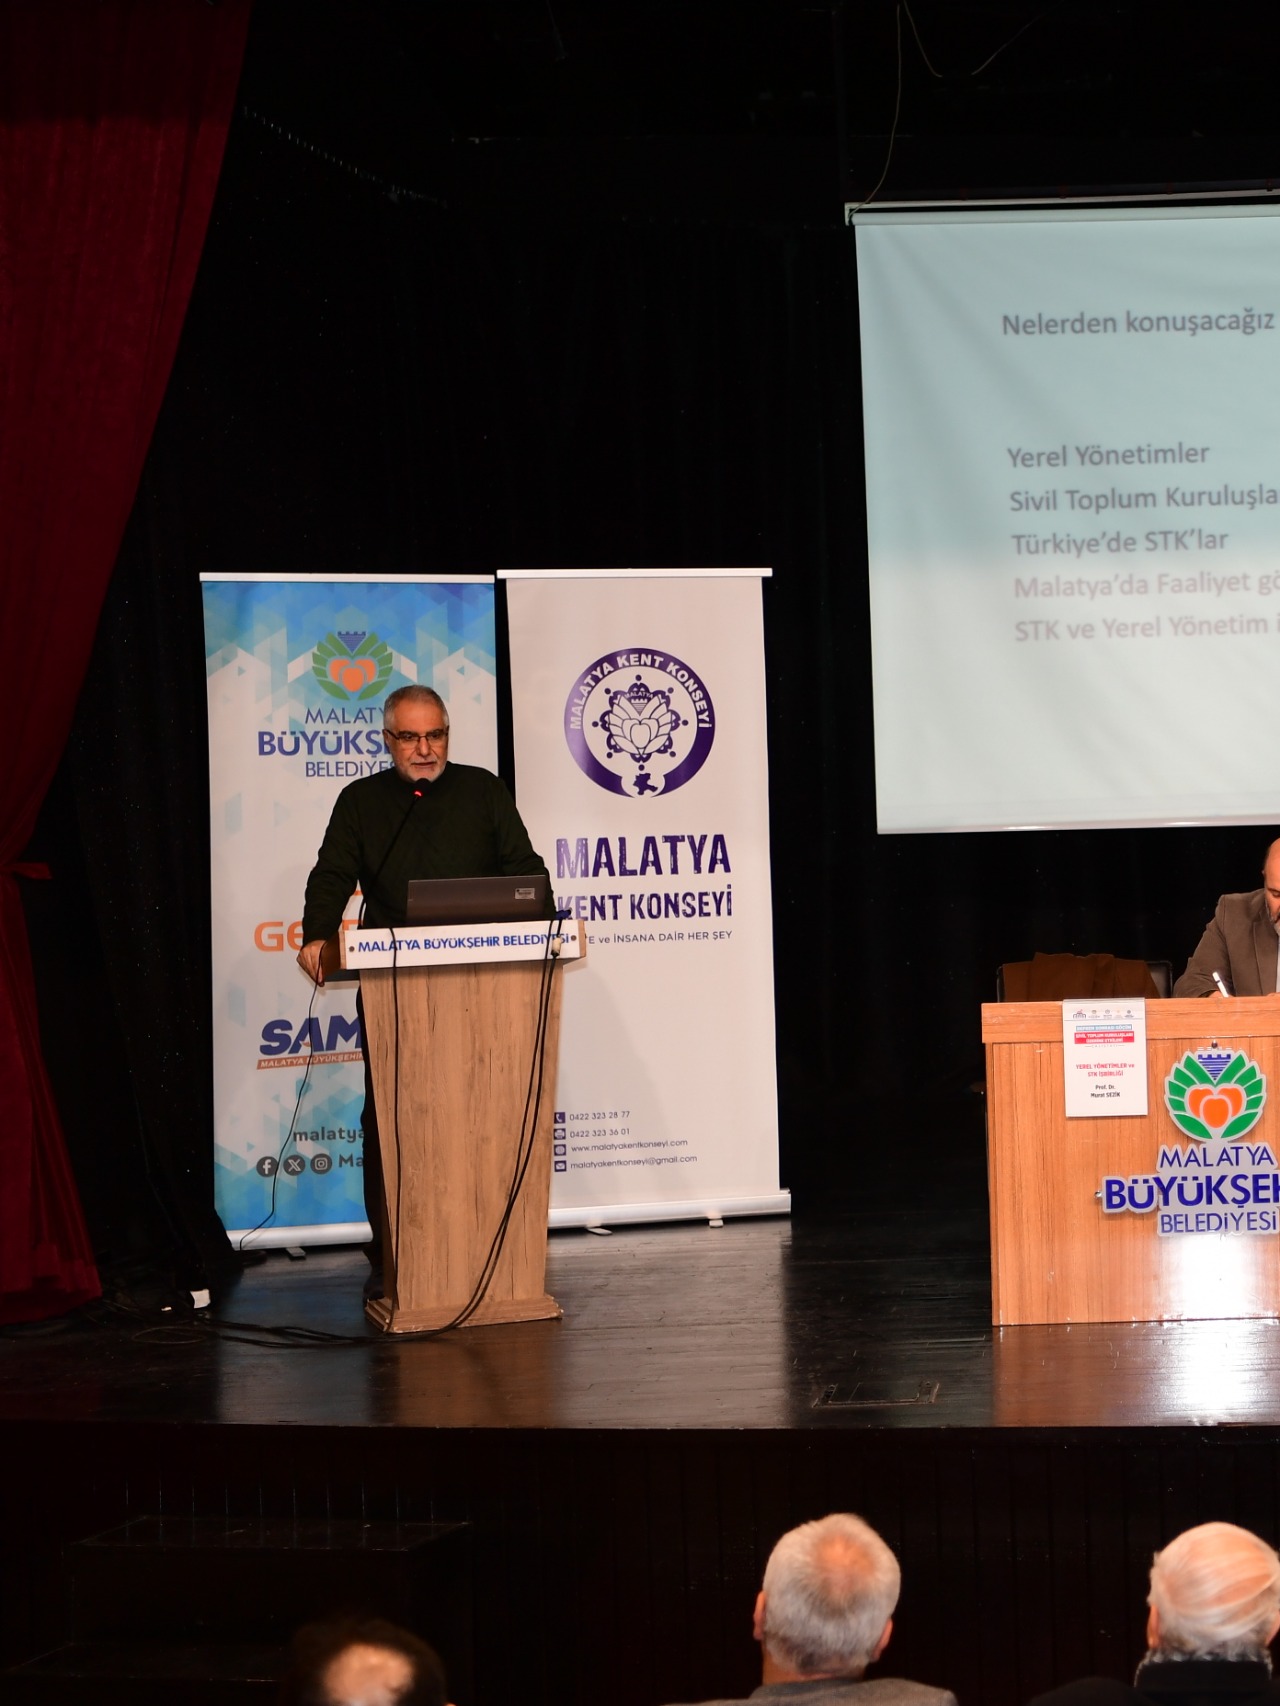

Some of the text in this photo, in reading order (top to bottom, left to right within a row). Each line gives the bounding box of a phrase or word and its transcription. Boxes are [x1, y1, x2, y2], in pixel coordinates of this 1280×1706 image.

[1002, 306, 1276, 337] Nelerden konuşacağız
[1007, 442, 1210, 469] Yerel Yönetimler
[1009, 490, 1058, 512] Sivil
[1065, 488, 1157, 515] Toplum
[1157, 570, 1251, 599] Faaliyet
[1015, 619, 1059, 642] STK
[1067, 622, 1095, 640] ve
[1103, 616, 1161, 639] Yerel
[1168, 613, 1269, 638] Yönetim
[570, 653, 713, 730] MALATYA KENT KONSEYİ
[305, 707, 384, 724] MALAT
[556, 833, 732, 879] MALATYA
[557, 884, 733, 922] KENT KONSEYİ
[358, 940, 421, 953] MALATYA
[424, 936, 500, 950] BÜYÜKŞEHİR
[613, 932, 655, 943] İNSANA
[658, 931, 685, 942] DAİR
[687, 931, 709, 941] HER
[712, 930, 733, 941] ŞEY
[260, 1058, 304, 1068] MALATYA
[569, 1113, 589, 1121] 0422
[592, 1112, 606, 1120] 323
[621, 1110, 630, 1118] 77
[569, 1130, 590, 1138] 0422
[592, 1129, 607, 1137] 323
[609, 1128, 619, 1136] 36
[571, 1139, 688, 1153] www.malatyakentkonseyi.com
[1160, 1146, 1275, 1168] MALATYA
[570, 1155, 698, 1170] malatyakentkonseyi@gmail.com
[1160, 1211, 1277, 1234] BELEDİYESİ
